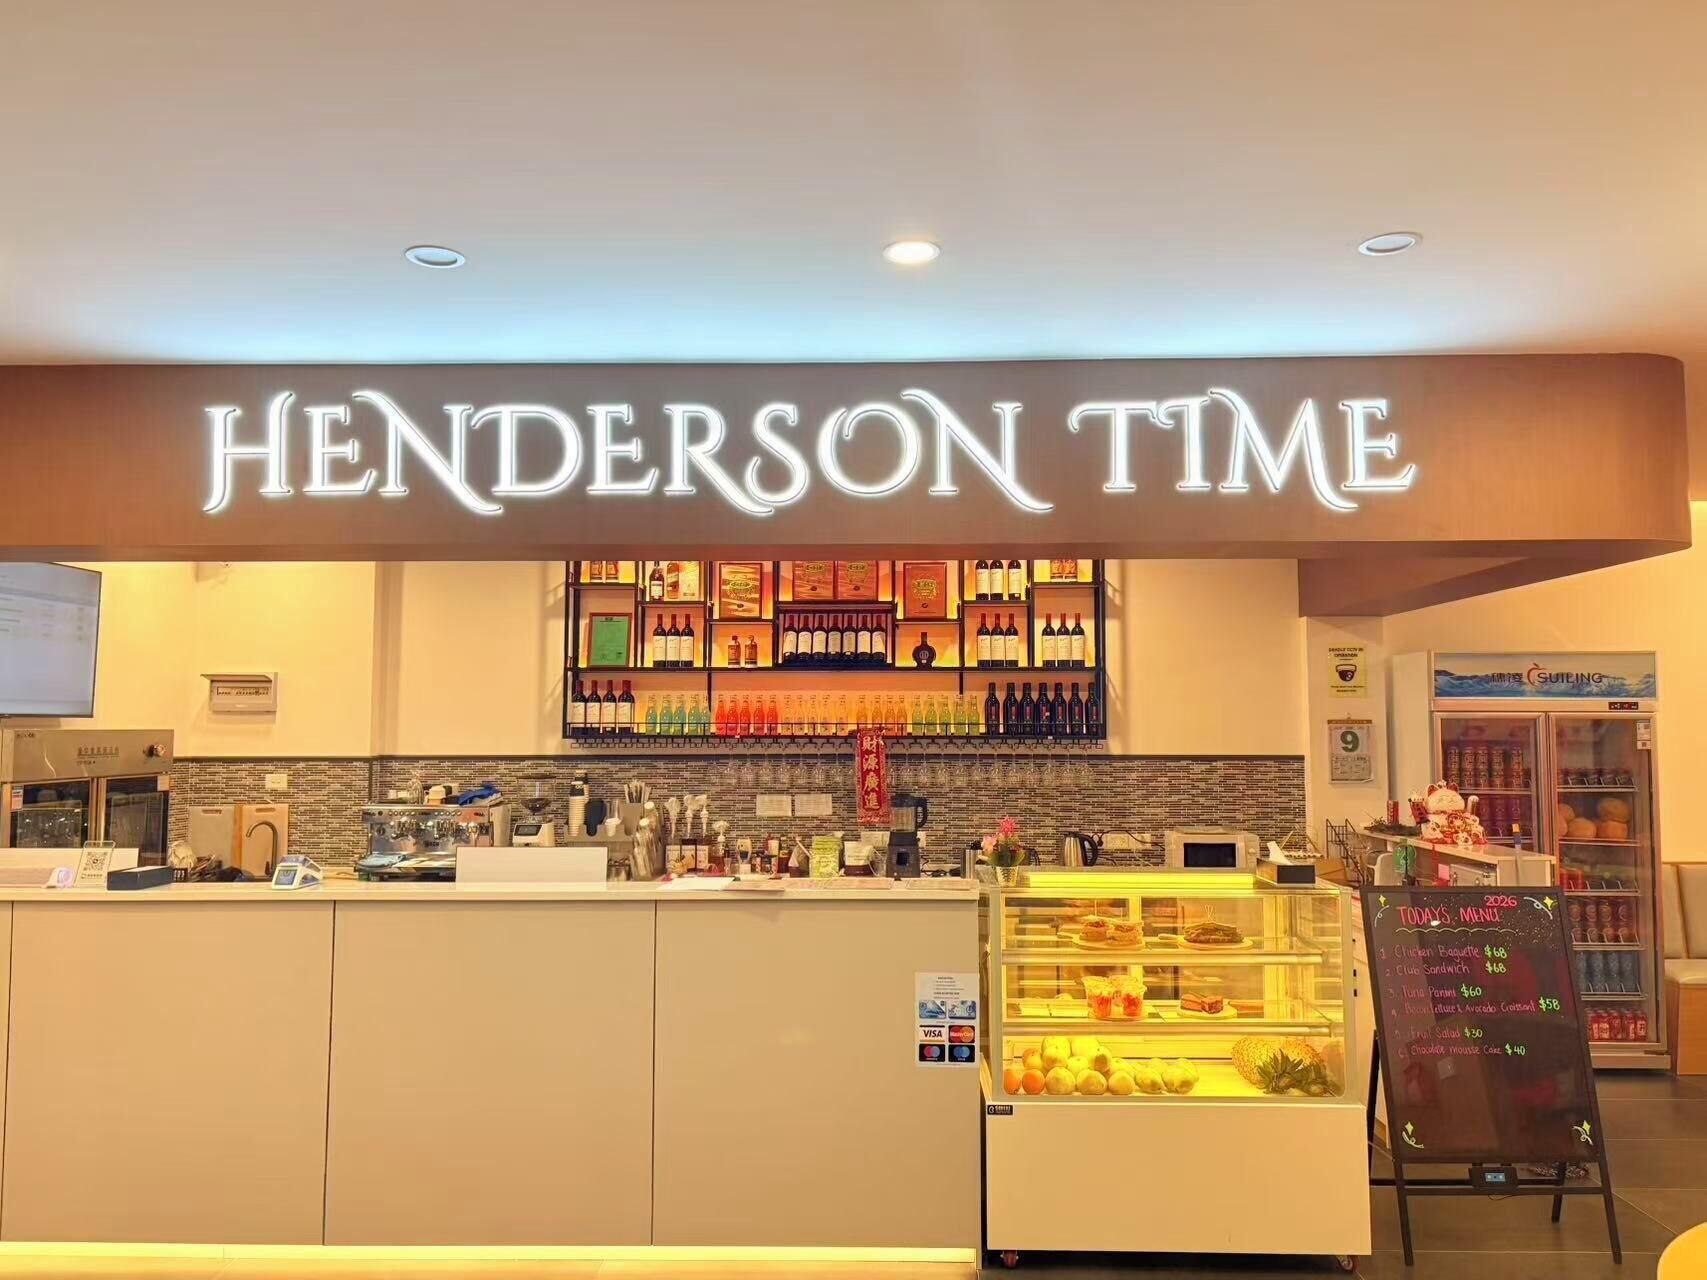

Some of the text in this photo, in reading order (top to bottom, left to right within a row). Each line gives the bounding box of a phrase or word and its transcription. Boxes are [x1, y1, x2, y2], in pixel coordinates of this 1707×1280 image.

[203, 388, 1415, 516] HENDERSON TIME
[1537, 672, 1603, 684] SUILING
[1340, 730, 1359, 752] 9
[862, 735, 880, 809] 財源廣進
[1484, 895, 1517, 907] 2026
[1459, 905, 1500, 923] MENU
[1394, 944, 1434, 958] Chicken
[1438, 944, 1481, 962] Baguette
[1484, 944, 1507, 959] $68
[1396, 964, 1420, 976] Club
[1423, 961, 1470, 976] Sandwich
[1485, 960, 1507, 974] $68
[1461, 984, 1482, 998] $60
[1465, 1002, 1497, 1013] Avocado
[1500, 1002, 1536, 1013] Croissant
[1538, 997, 1561, 1012] $58
[923, 1029, 943, 1038] VISA
[1436, 1026, 1461, 1039] Salad
[1464, 1027, 1483, 1038] $30
[1505, 1043, 1526, 1056] $40
